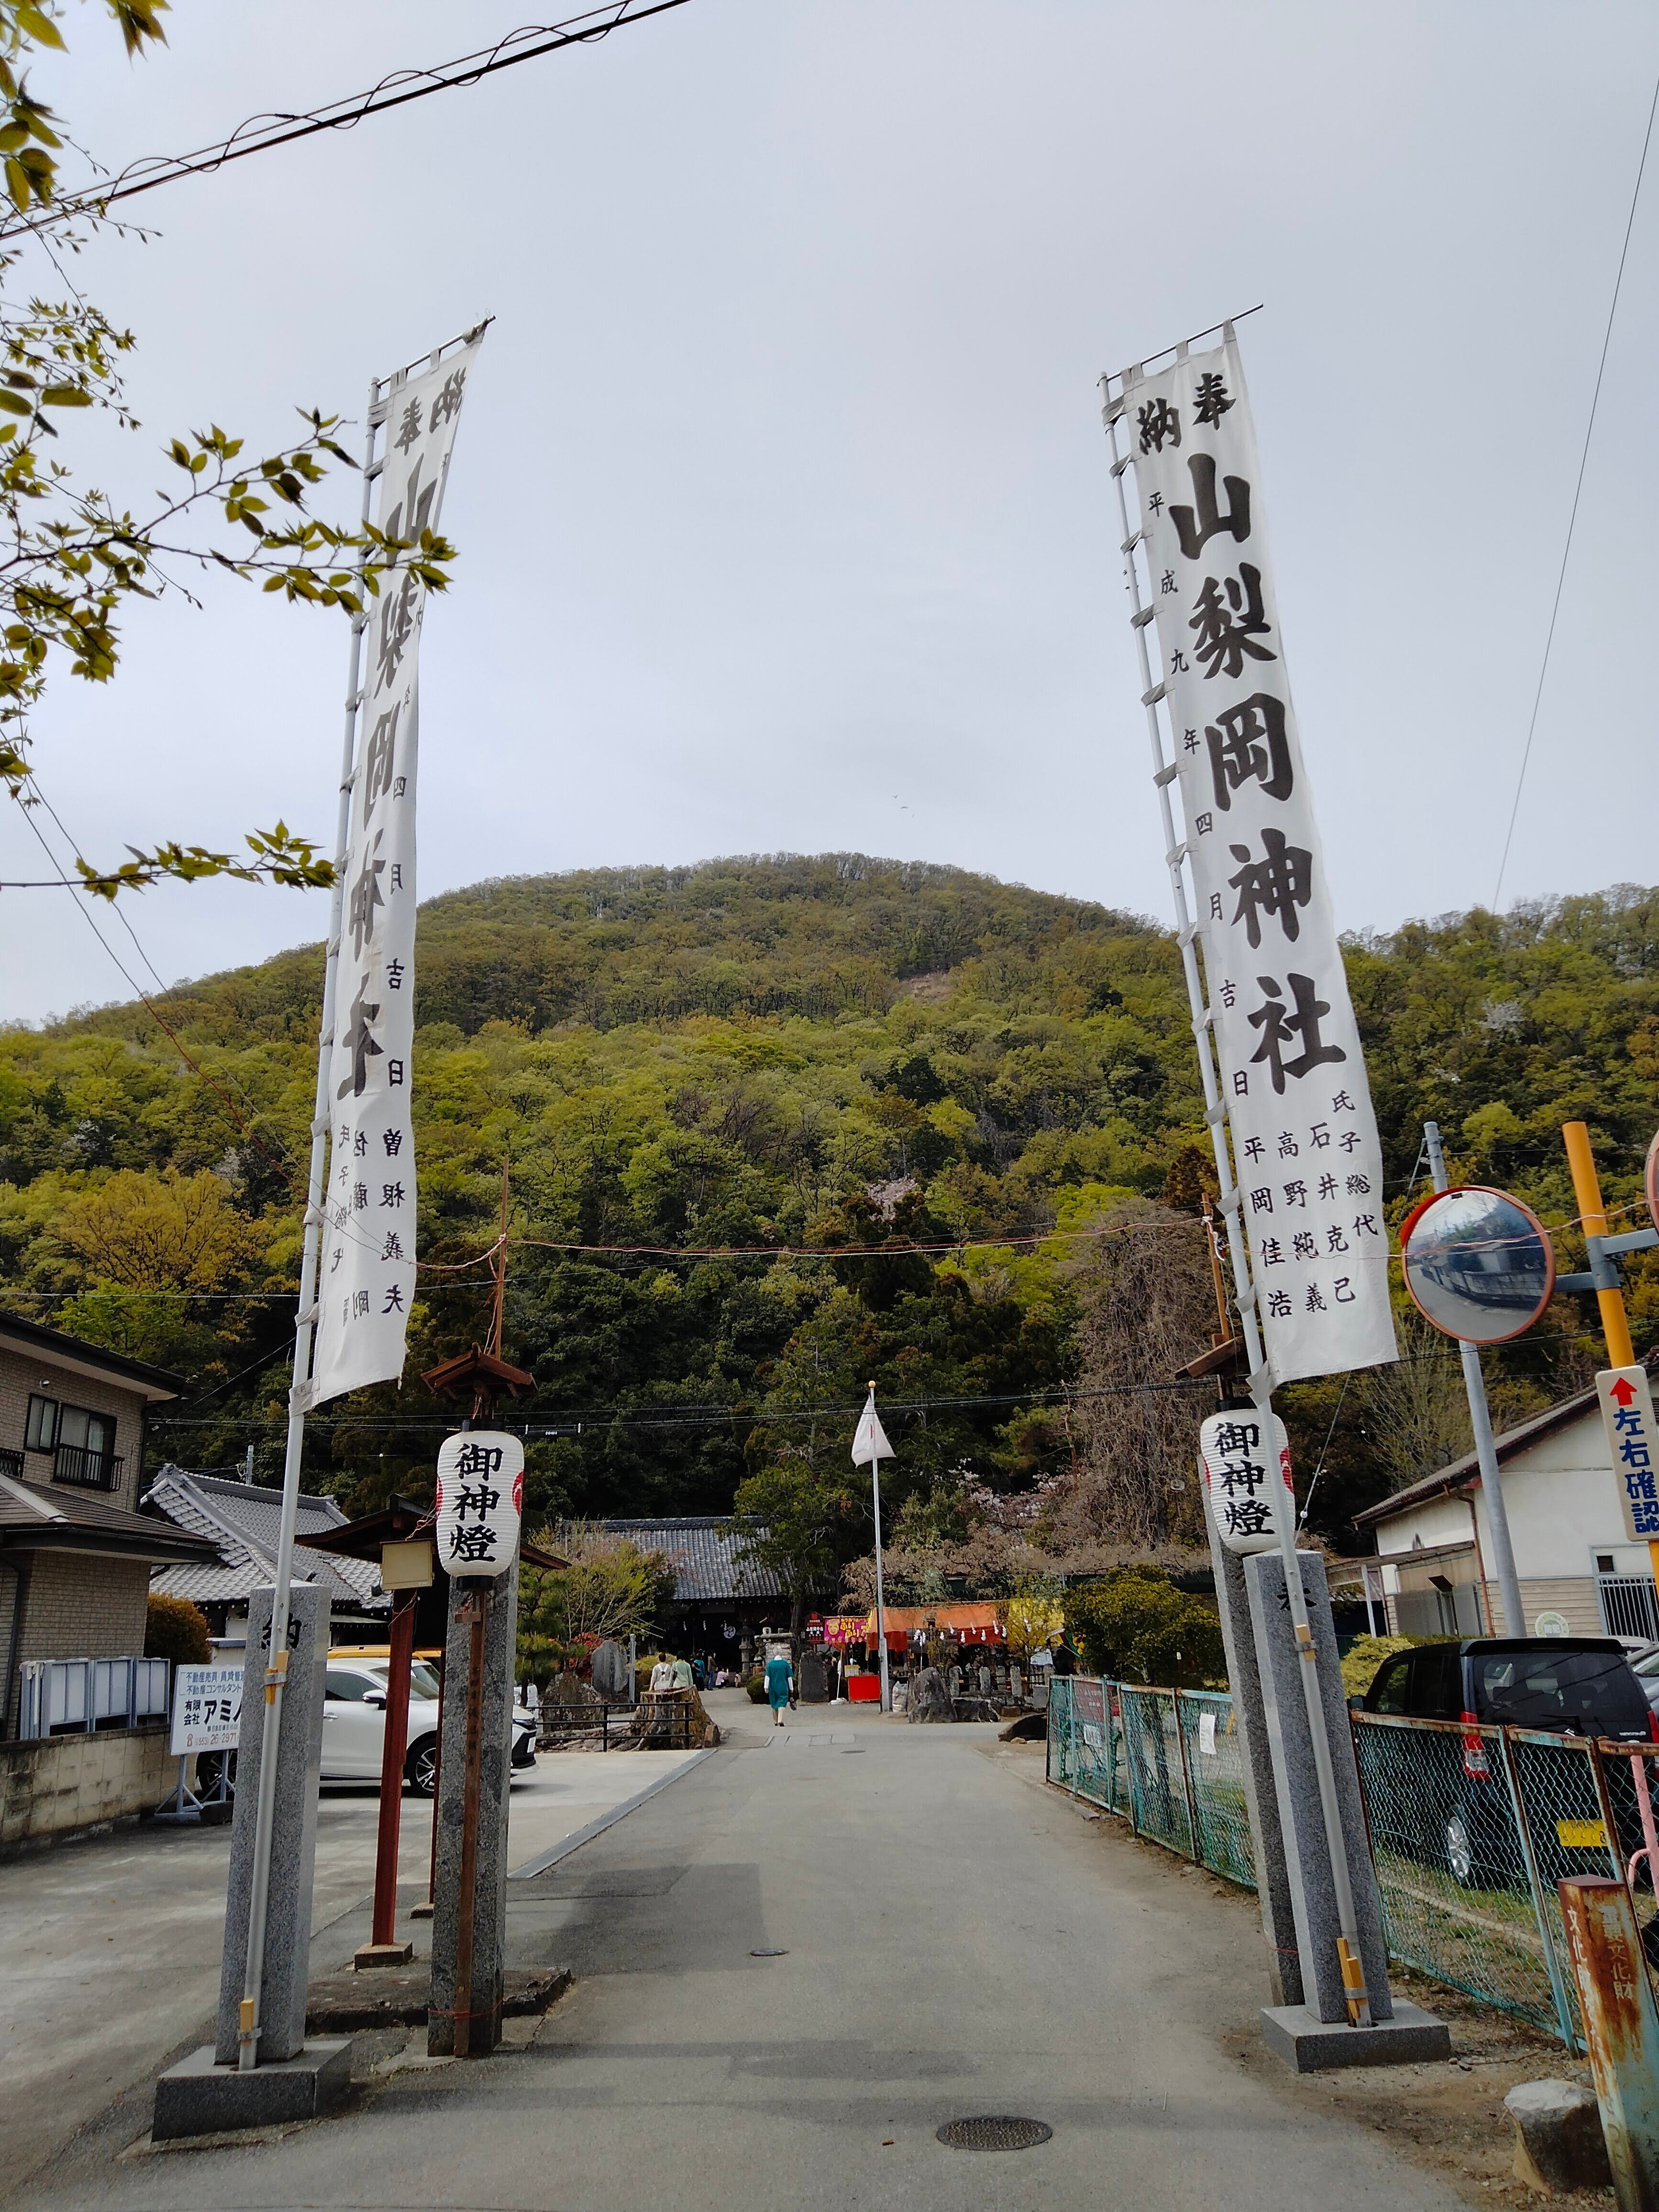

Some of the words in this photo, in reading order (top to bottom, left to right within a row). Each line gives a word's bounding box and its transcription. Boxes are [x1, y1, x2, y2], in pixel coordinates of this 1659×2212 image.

[1149, 492, 1249, 1095] 平成九年四月吉日
[1168, 453, 1347, 1095] 山梨岡神社
[1243, 1136, 1293, 1318] 平岡佳浩
[1276, 1131, 1327, 1314] 高野純義
[1309, 1122, 1356, 1304] 石井克己
[1332, 1090, 1378, 1237] 氏子総代
[449, 1443, 504, 1562] 御神燈
[1214, 1422, 1275, 1537] 御神燈
[1614, 1408, 1659, 1533] 左右確認
